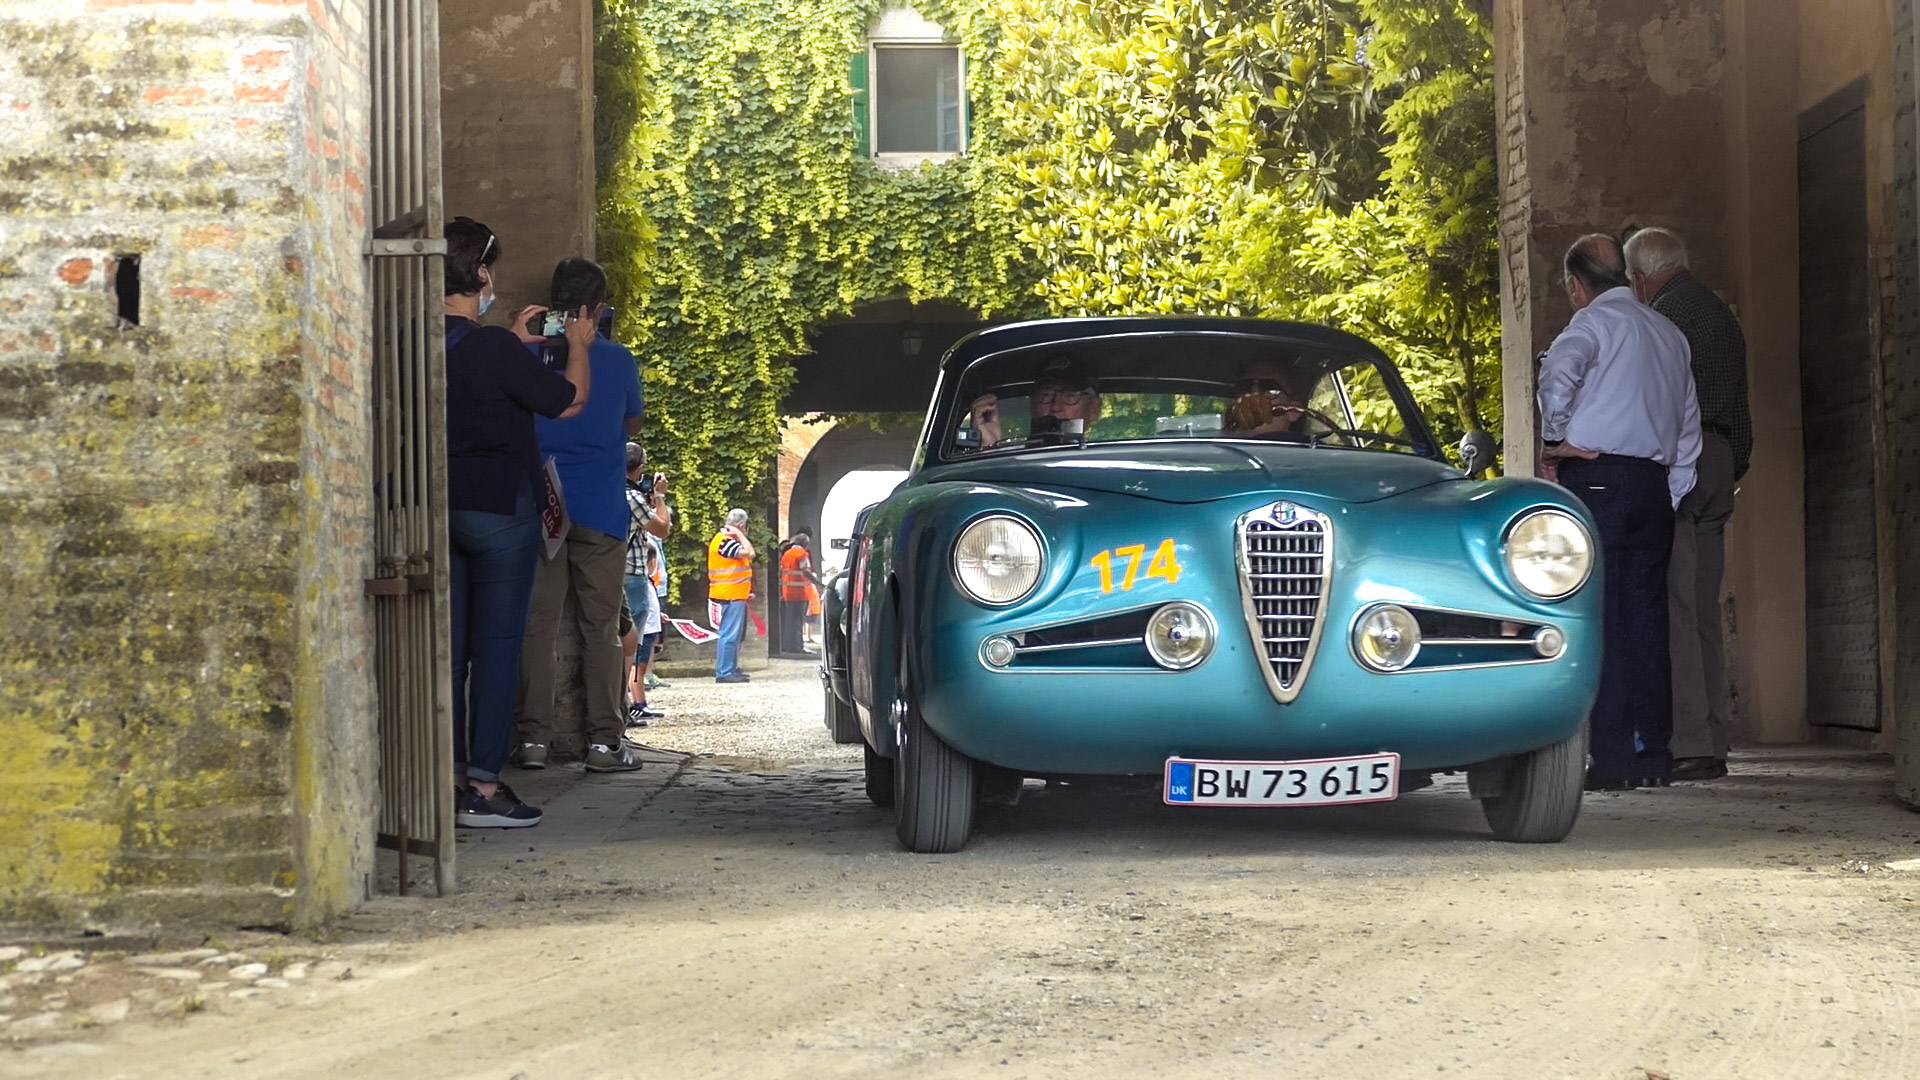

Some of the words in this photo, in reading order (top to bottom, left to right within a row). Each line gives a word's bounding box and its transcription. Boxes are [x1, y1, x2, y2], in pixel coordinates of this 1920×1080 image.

[1090, 538, 1182, 594] 174
[1171, 784, 1187, 796] DK
[1197, 768, 1250, 798] BW
[1262, 769, 1308, 799] 73
[1320, 762, 1389, 797] 615
